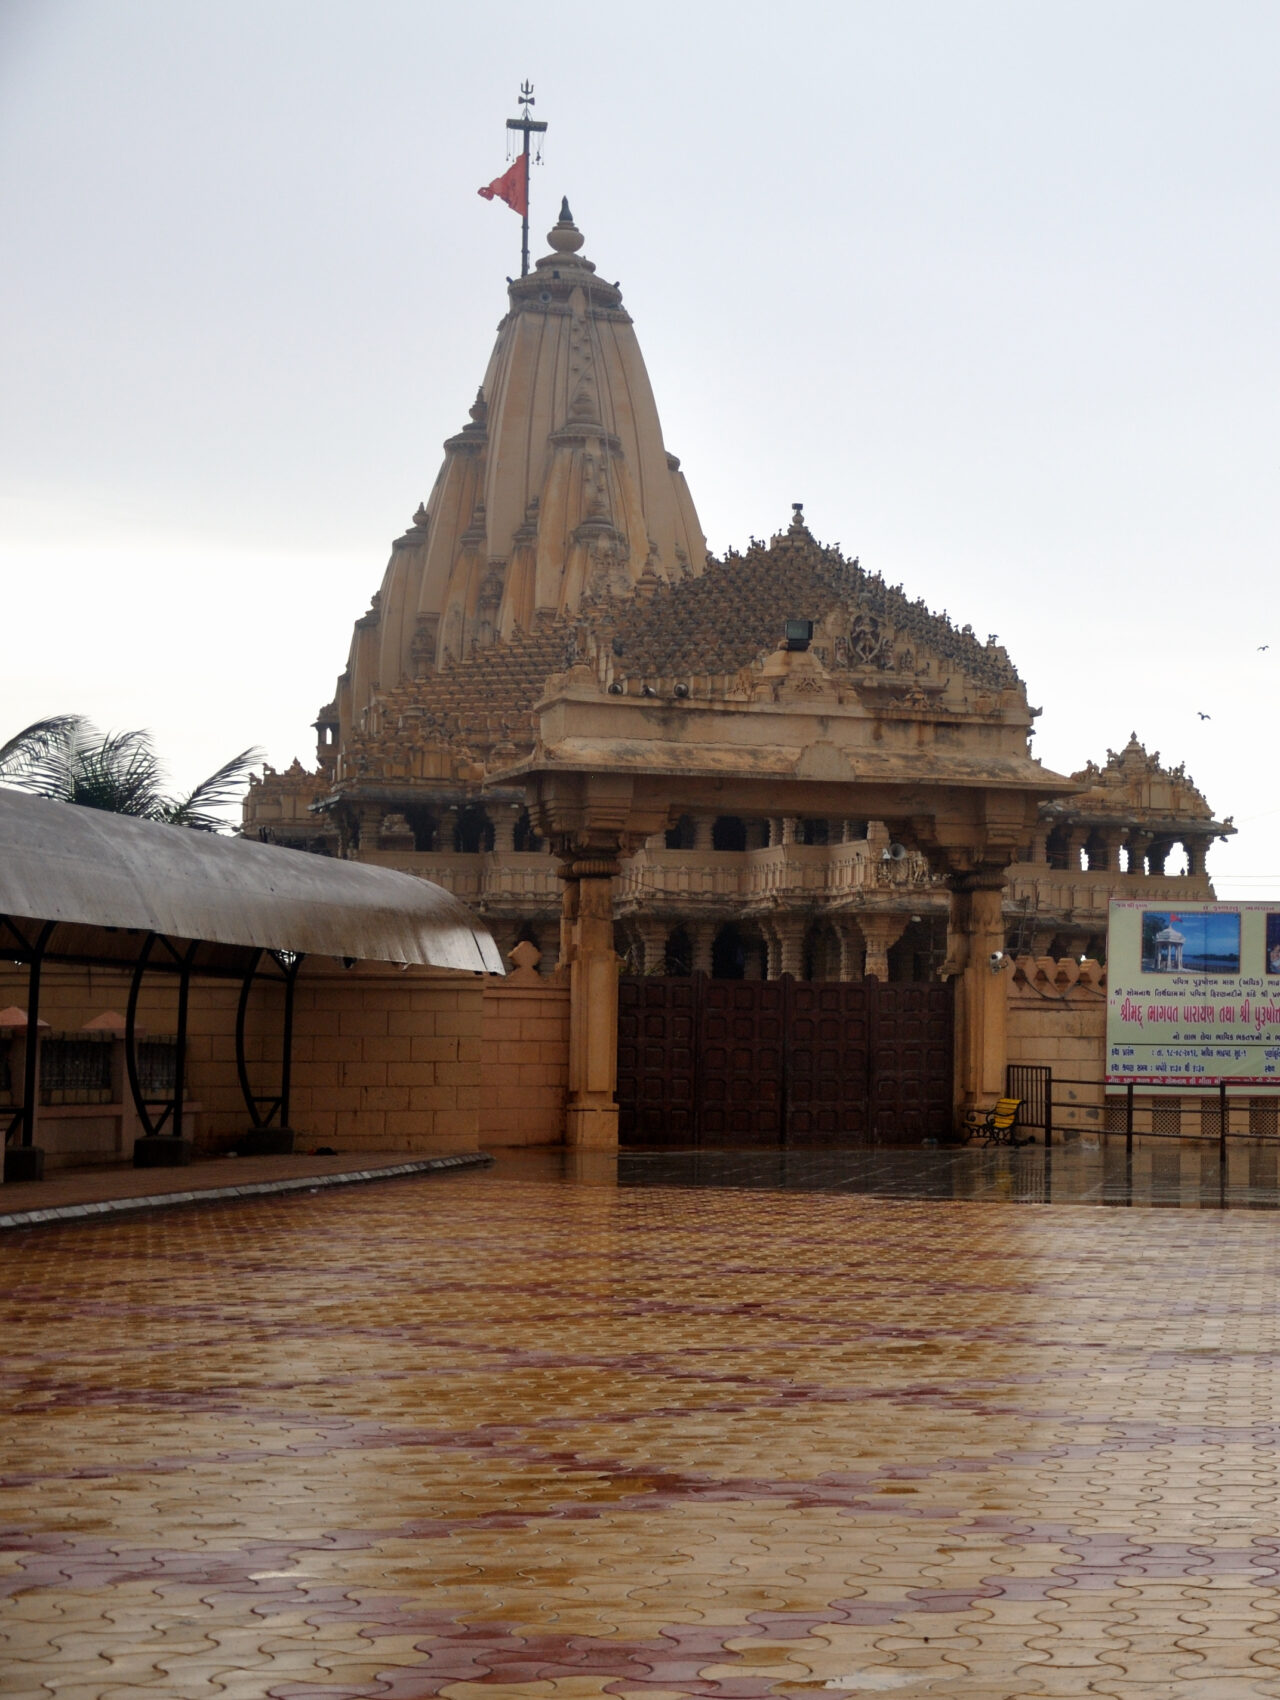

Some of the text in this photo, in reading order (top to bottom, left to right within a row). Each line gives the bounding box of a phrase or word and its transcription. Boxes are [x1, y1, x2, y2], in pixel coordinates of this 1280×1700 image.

[1114, 988, 1122, 996] શ્રી
[1127, 988, 1151, 996] સોમનાથ
[1189, 989, 1206, 997] પવિત્ર
[1120, 997, 1144, 1029] શ્રીમદ્
[1147, 1005, 1179, 1023] ભાગવત
[1183, 1005, 1215, 1024] પારાયણ
[1219, 1006, 1235, 1024] તથા
[1239, 999, 1250, 1024] શ્રી
[1172, 1032, 1180, 1041] નો
[1183, 1033, 1197, 1041] લાભ
